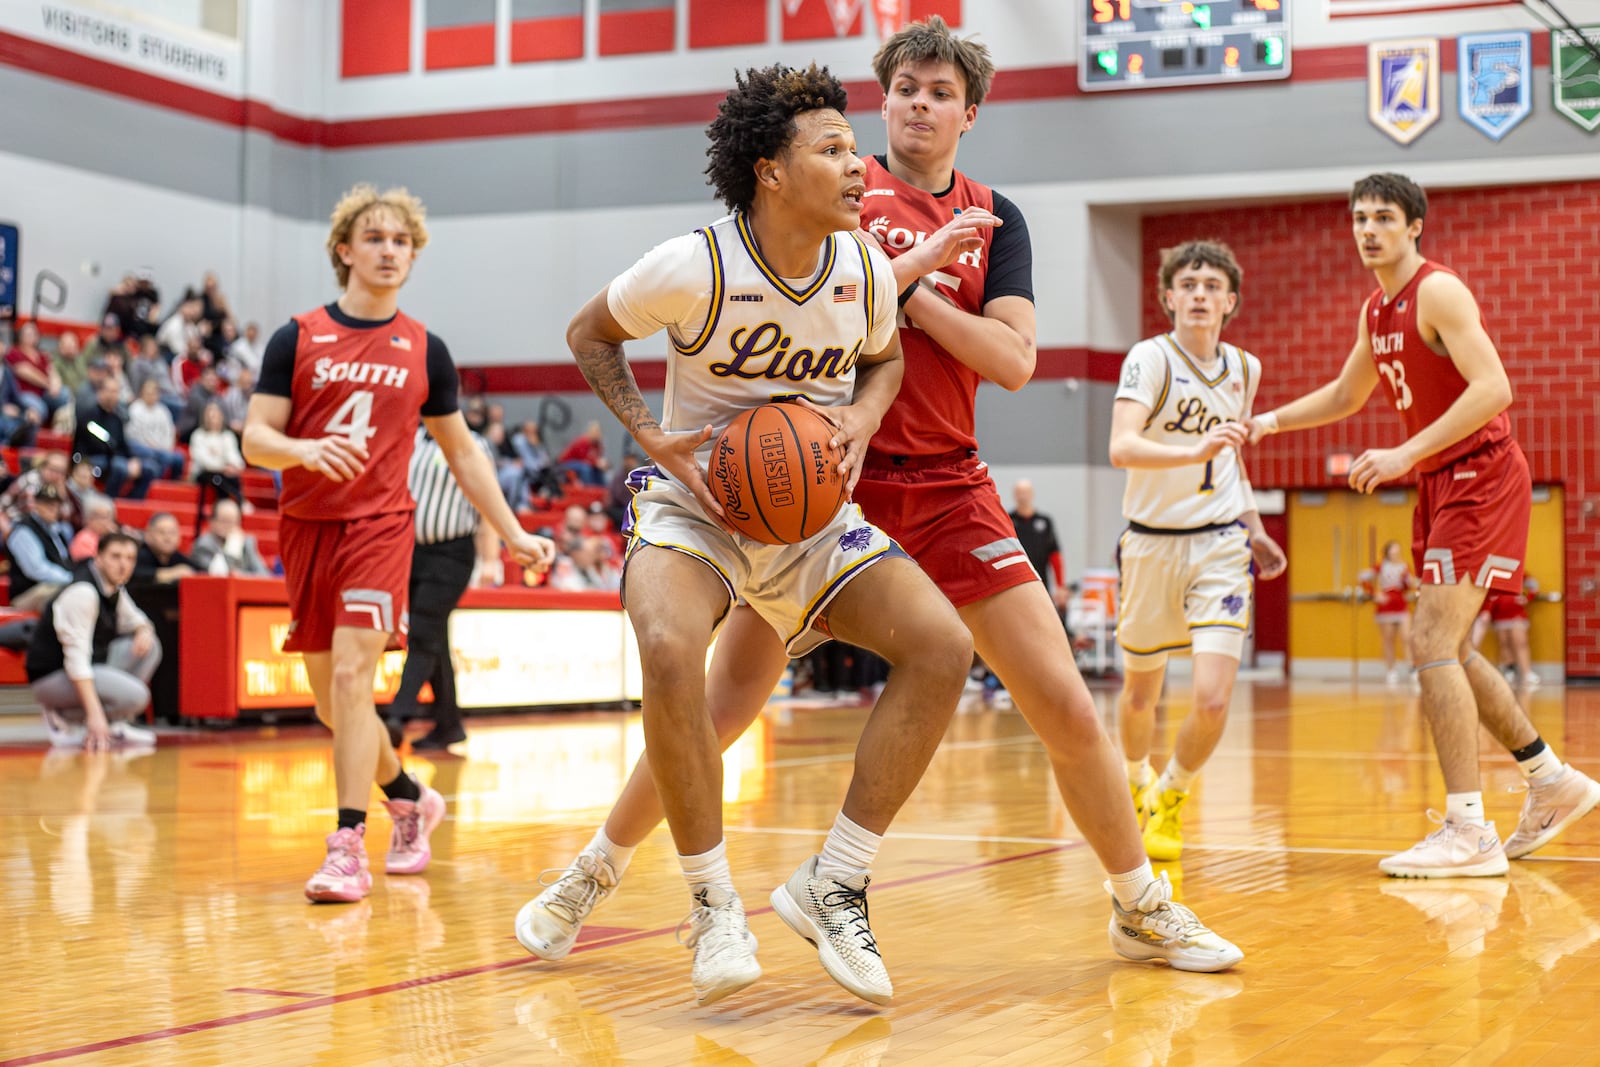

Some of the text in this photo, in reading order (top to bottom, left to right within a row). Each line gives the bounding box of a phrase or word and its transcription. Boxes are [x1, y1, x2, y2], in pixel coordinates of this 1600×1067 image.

[41, 5, 227, 81] VISITORS STUDENTS
[869, 224, 982, 269] SOH
[311, 357, 409, 389] SOUTH
[324, 390, 377, 453] 4
[715, 436, 750, 520] Rawlings
[759, 431, 795, 508] OHSAA
[811, 441, 825, 475] NFHS
